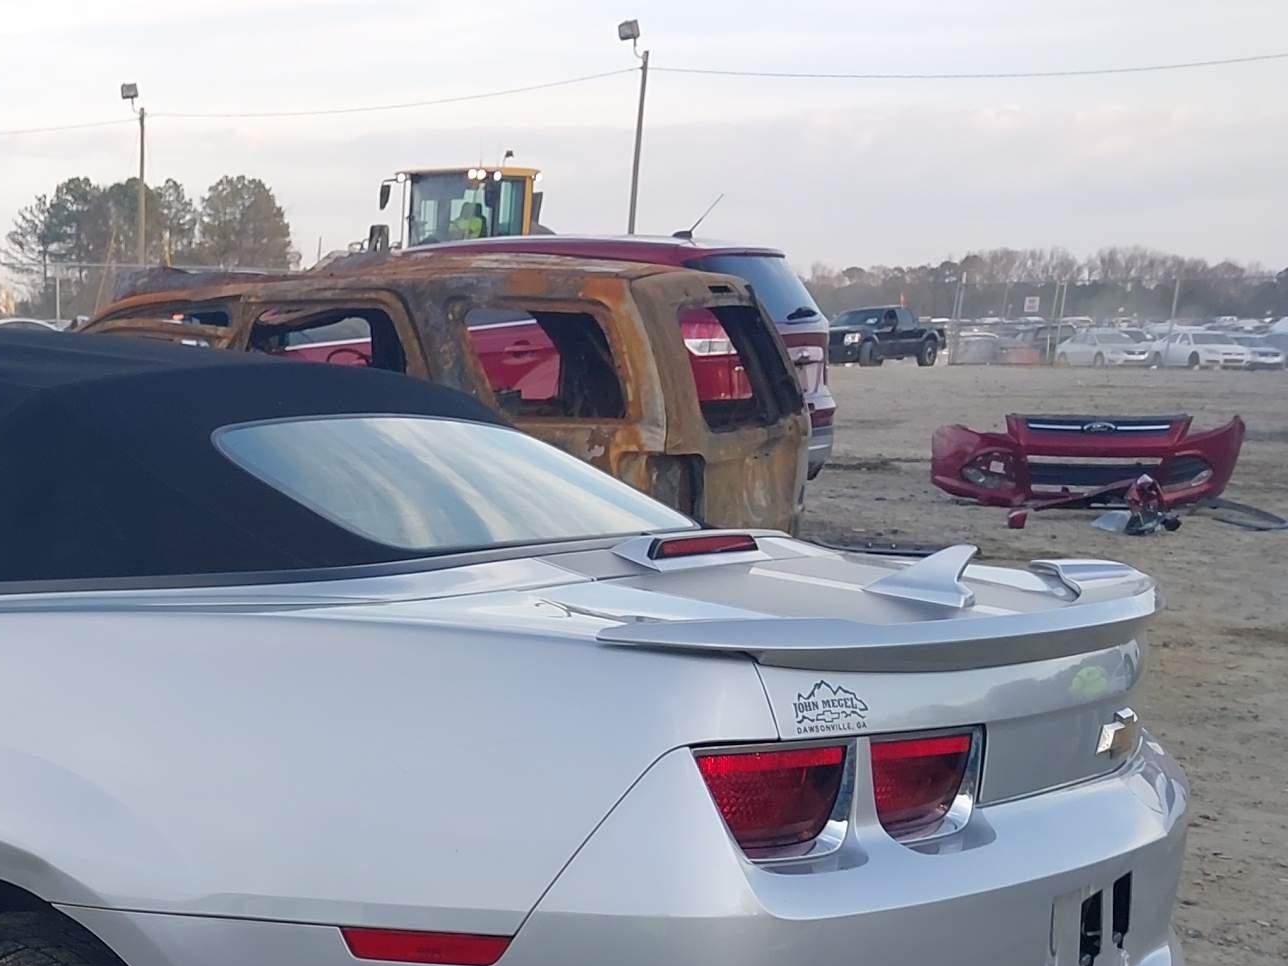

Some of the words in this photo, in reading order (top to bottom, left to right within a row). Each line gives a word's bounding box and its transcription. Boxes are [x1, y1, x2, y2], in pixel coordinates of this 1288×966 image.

[793, 700, 820, 718] JOHN
[821, 697, 858, 711] MEGEL
[856, 721, 868, 729] GA
